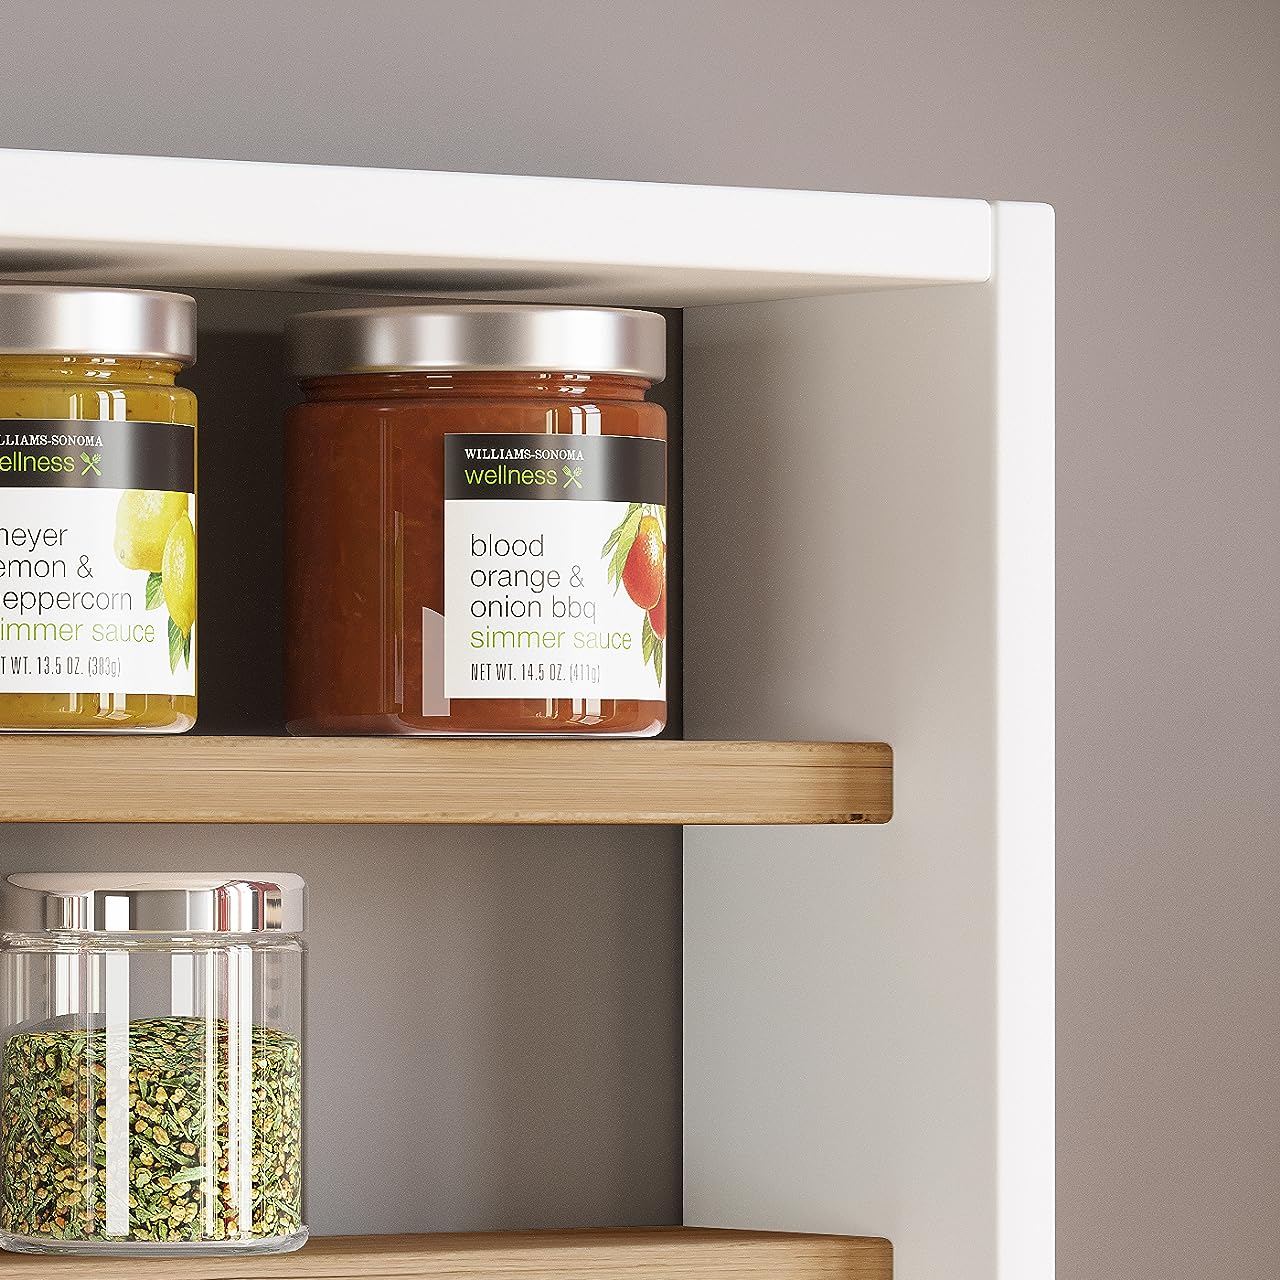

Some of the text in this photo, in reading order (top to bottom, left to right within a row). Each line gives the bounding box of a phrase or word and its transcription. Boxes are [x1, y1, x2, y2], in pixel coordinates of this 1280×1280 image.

[464, 449, 585, 461] WILLIAMS-SONOMA
[464, 465, 558, 486] wellness
[471, 534, 544, 557] blood
[76, 555, 94, 579] &
[470, 565, 585, 593] orange &
[470, 595, 597, 624] onion bbq
[91, 624, 155, 642] sauce
[470, 626, 632, 650] simmer sauce
[11, 656, 32, 675] WT.
[37, 656, 61, 675] 13.5
[67, 656, 83, 675] OZ.
[88, 656, 120, 678] (383g)
[471, 663, 492, 681] NET
[496, 663, 517, 681] WT.
[521, 663, 544, 681] 14.5
[549, 663, 566, 681] OZ.
